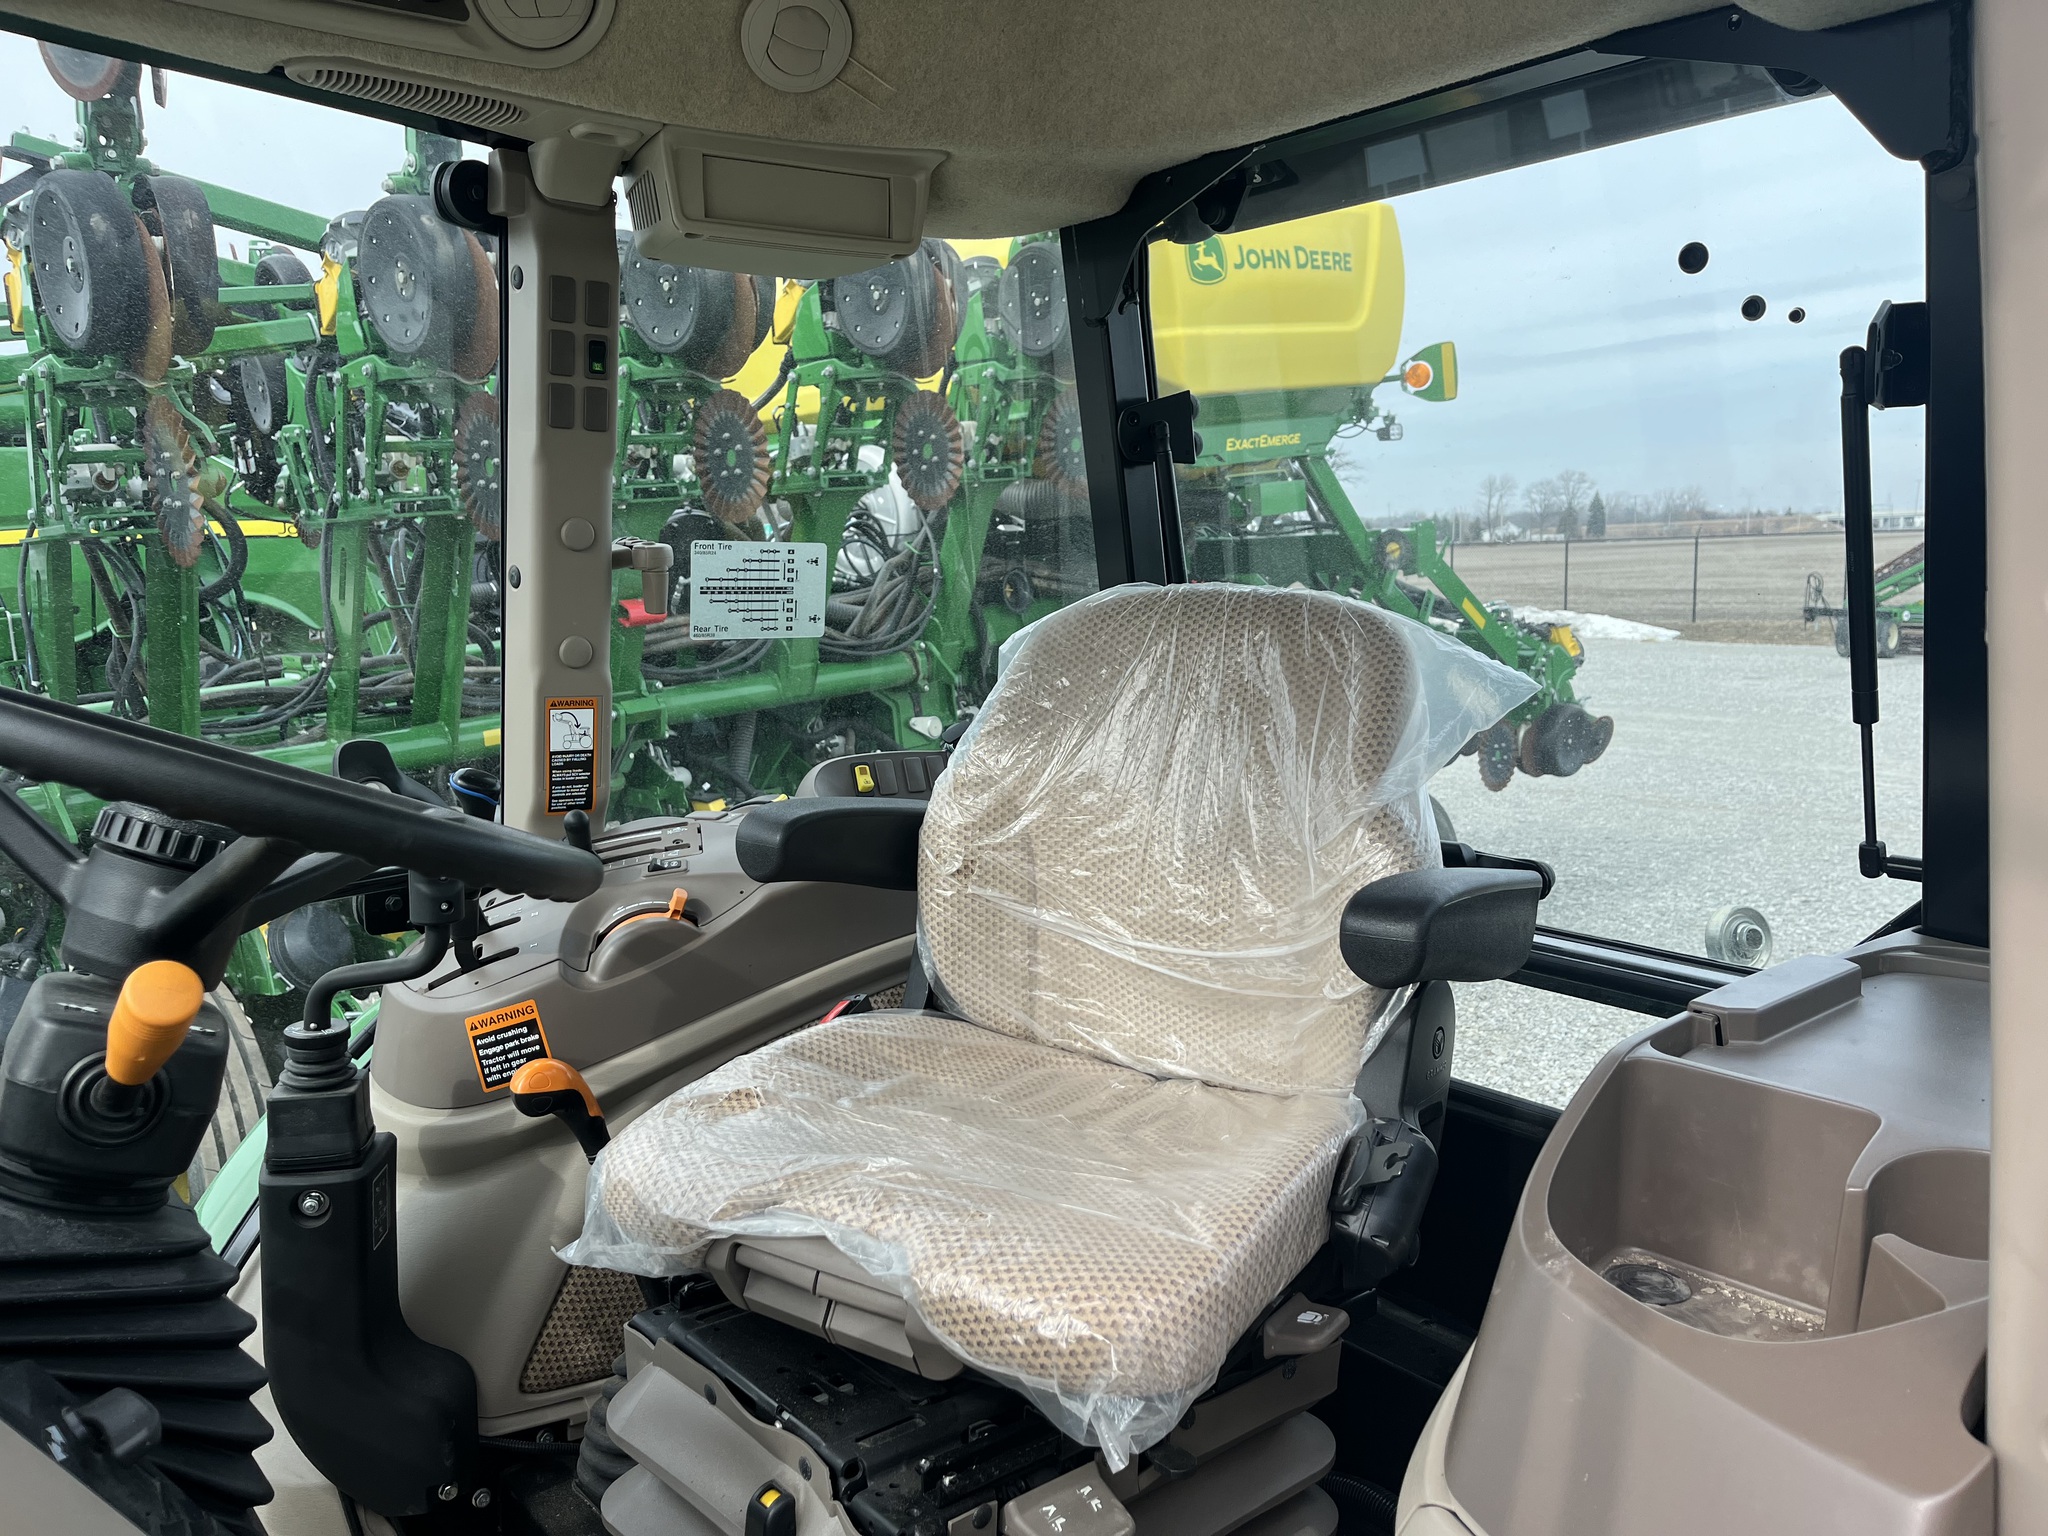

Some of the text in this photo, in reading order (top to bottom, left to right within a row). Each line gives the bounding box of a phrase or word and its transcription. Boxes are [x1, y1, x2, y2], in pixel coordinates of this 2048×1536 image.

[1234, 244, 1353, 272] JOHN DEERE
[1226, 433, 1301, 451] EXACTEMERGE
[694, 542, 715, 550] Front
[478, 1005, 535, 1029] WARNING
[476, 1026, 528, 1046] Avoid crushing
[478, 1033, 540, 1056] Engage park brake
[481, 1044, 540, 1066] Tractor will move
[484, 1067, 489, 1075] if
[490, 1063, 502, 1073] left
[511, 1057, 527, 1068] gear
[486, 1068, 518, 1083] with eng
